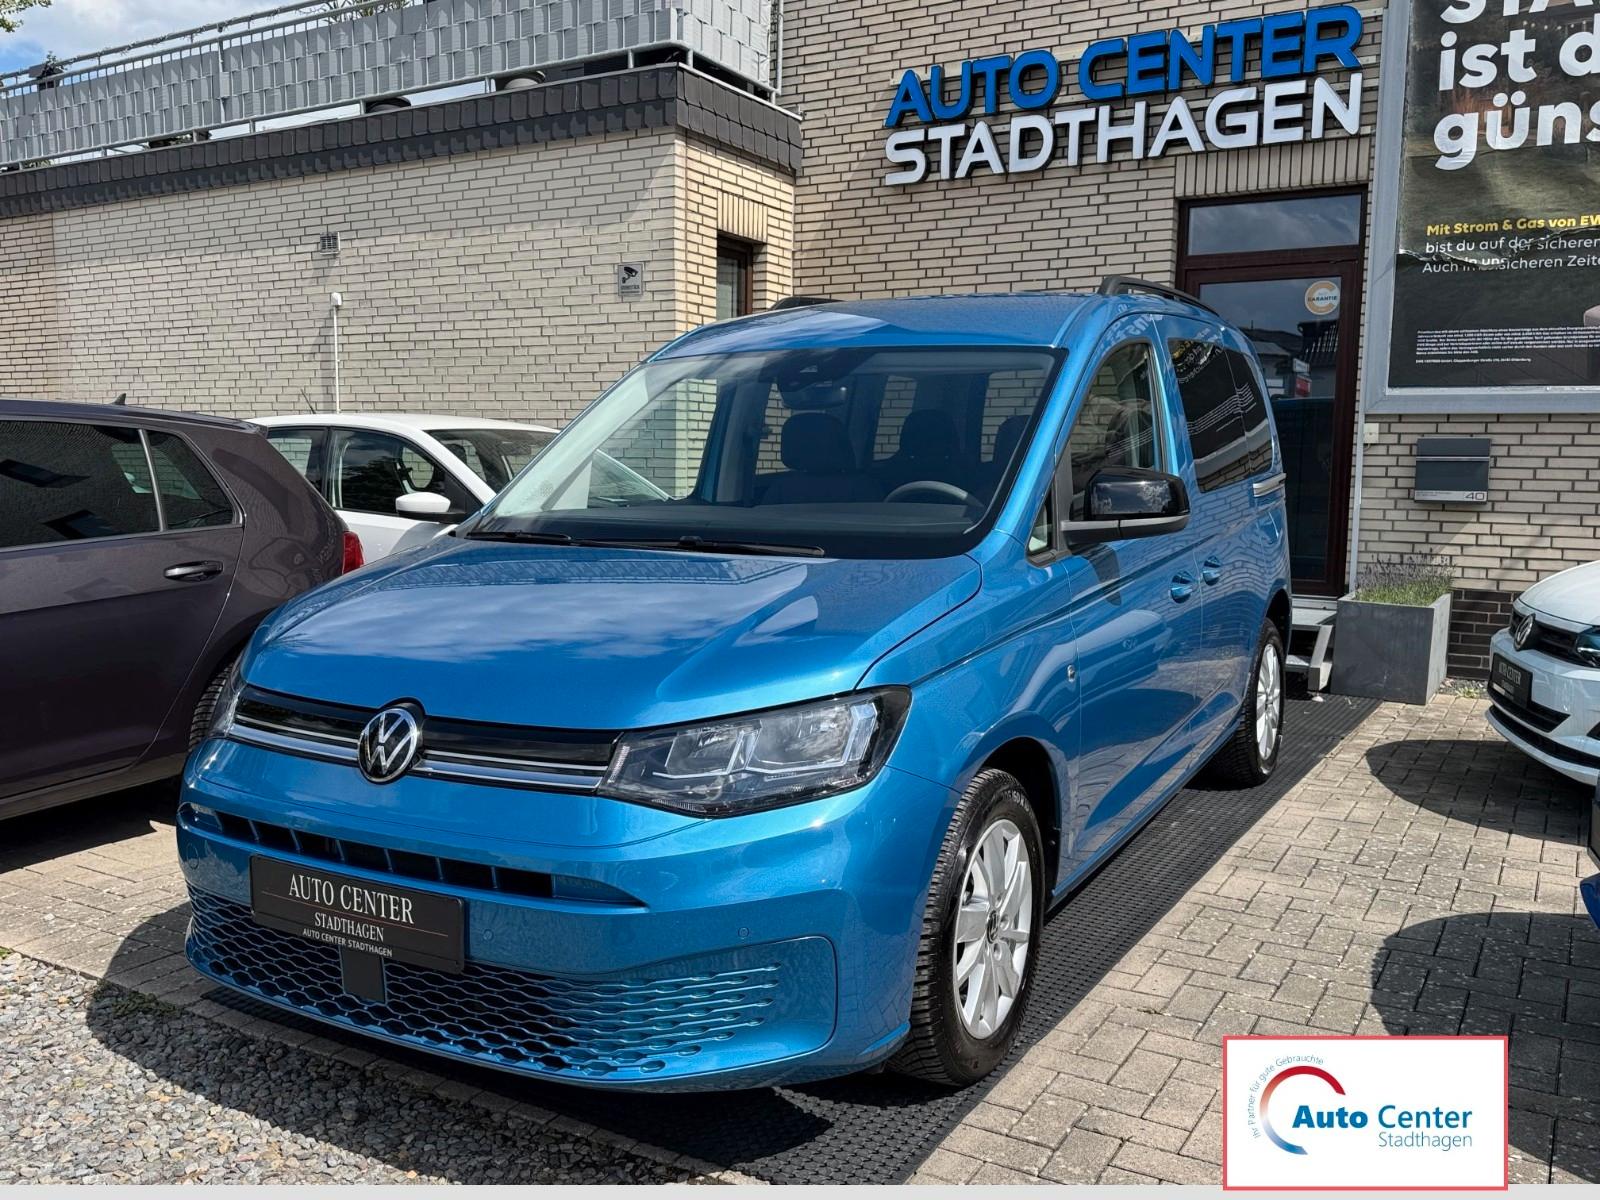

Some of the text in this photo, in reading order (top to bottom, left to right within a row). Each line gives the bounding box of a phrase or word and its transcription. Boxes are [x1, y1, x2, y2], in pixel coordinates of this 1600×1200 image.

[884, 6, 1363, 128] AUTO CENTER
[1439, 29, 1537, 91] ist
[884, 72, 1363, 186] STADTHAGEN
[1426, 225, 1451, 236] Mit
[1453, 221, 1498, 234] Strom
[1502, 219, 1513, 231] &
[1516, 218, 1545, 230] Gas
[1548, 217, 1576, 228] von
[1425, 242, 1452, 254] bist
[1456, 240, 1475, 252] du
[1479, 238, 1505, 250] auf
[1422, 262, 1459, 274] Auch
[1567, 254, 1600, 268] Zeit
[1463, 492, 1485, 501] 40
[288, 873, 415, 925] AUTO CENTER
[314, 911, 385, 943] STADTHAGEN
[302, 928, 393, 958] AUTO CENTER STADTHAGEN
